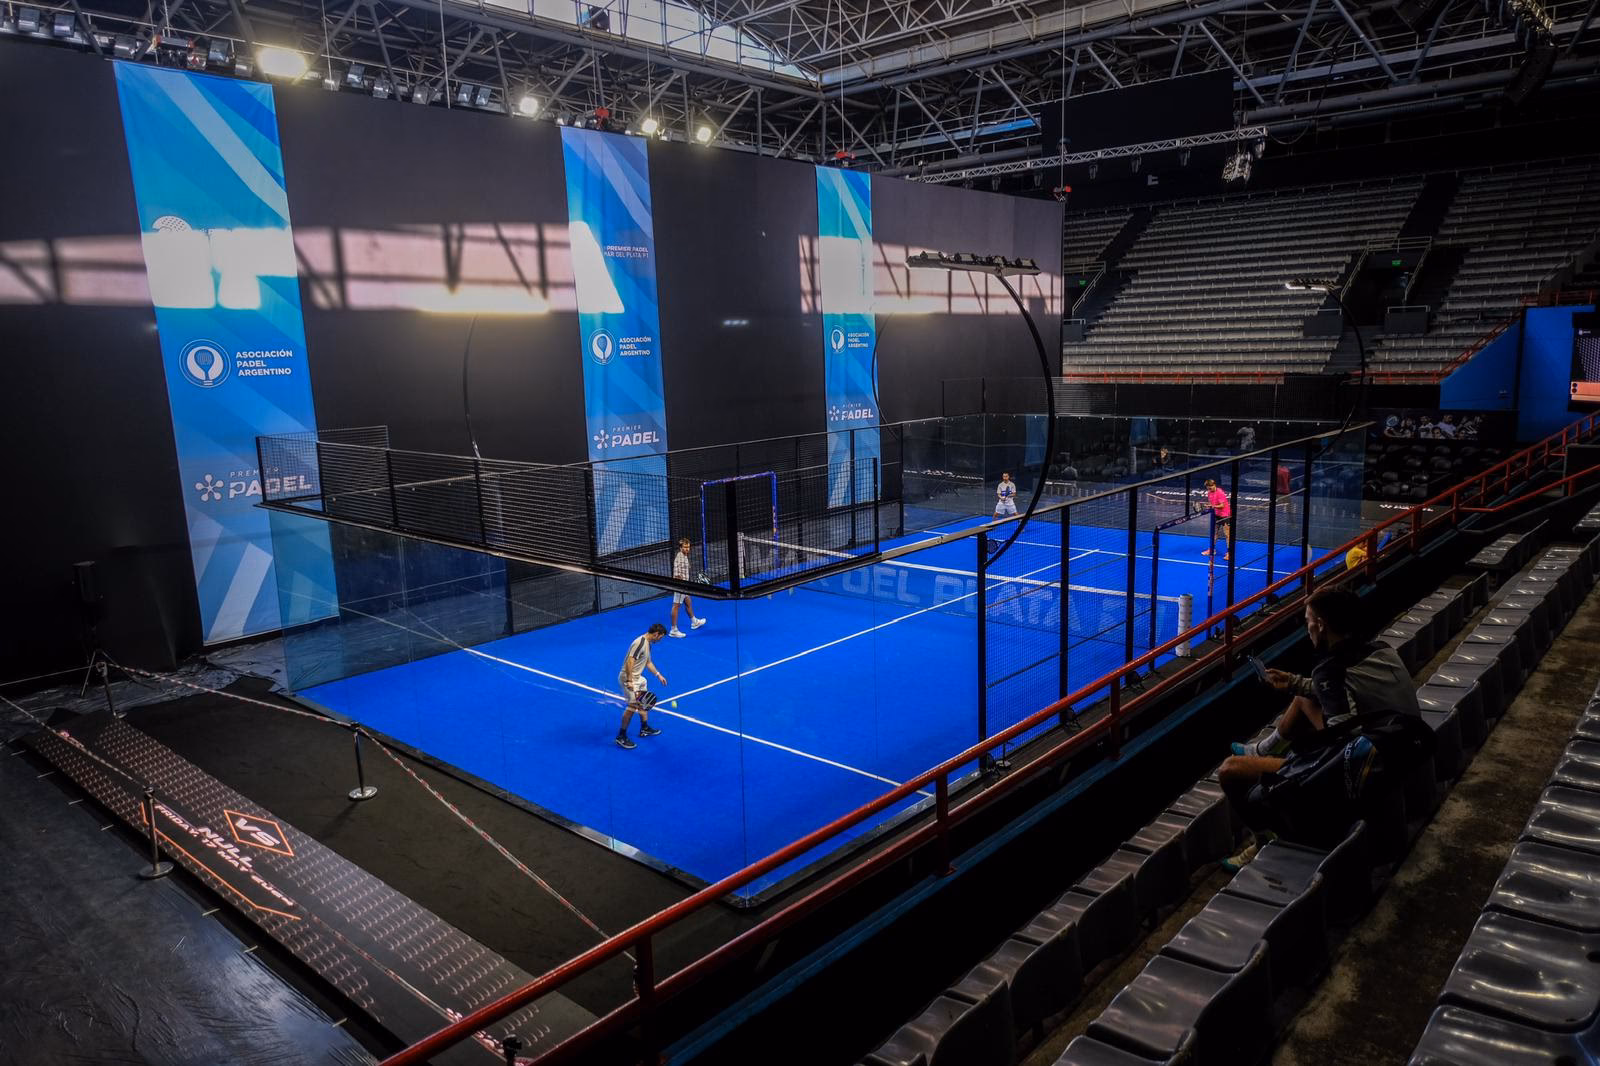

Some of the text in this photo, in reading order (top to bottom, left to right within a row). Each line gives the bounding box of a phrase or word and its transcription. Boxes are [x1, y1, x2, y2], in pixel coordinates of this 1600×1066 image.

[619, 335, 652, 343] ASOCIACIÓN
[235, 348, 293, 359] ASOCIACIÓN
[236, 359, 267, 368] PADEL
[238, 367, 292, 377] ARGENTINO
[841, 407, 874, 421] PADEL
[611, 430, 660, 448] PADEL
[228, 474, 313, 499] PADEL
[842, 563, 921, 605] DEL
[235, 817, 281, 847] VS
[198, 827, 253, 869] NULL
